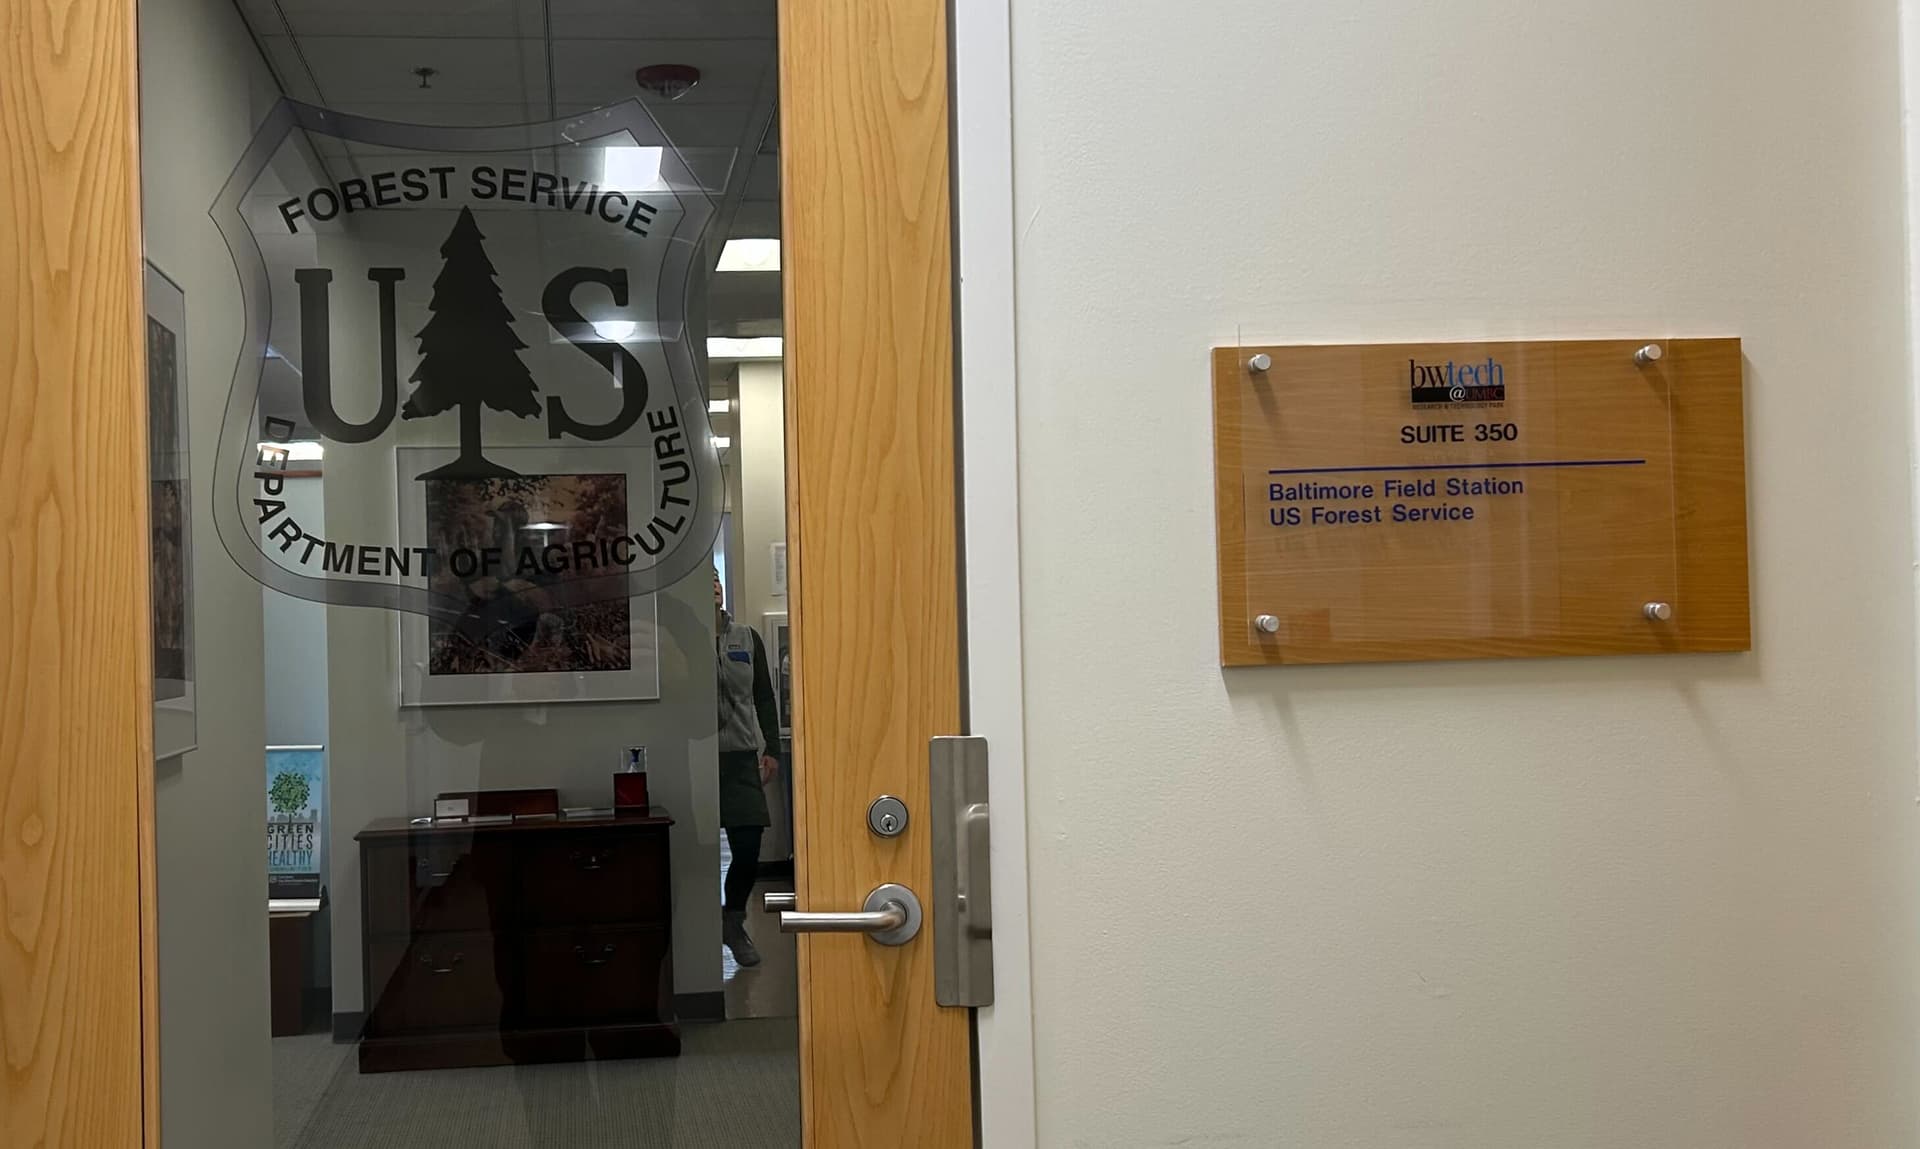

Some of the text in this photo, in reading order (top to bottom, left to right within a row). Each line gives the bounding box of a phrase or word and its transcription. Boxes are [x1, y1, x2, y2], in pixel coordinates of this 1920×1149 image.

[278, 166, 658, 238] FOREST SERVICE
[1409, 358, 1504, 389] bwtech
[1401, 423, 1518, 443] SUITE 350
[252, 405, 691, 578] DEPARTMENT OF AGRICULTURE
[1268, 477, 1524, 501] Baltimore Field Station
[1270, 503, 1474, 526] US Forest Service
[267, 824, 314, 834] GREEN
